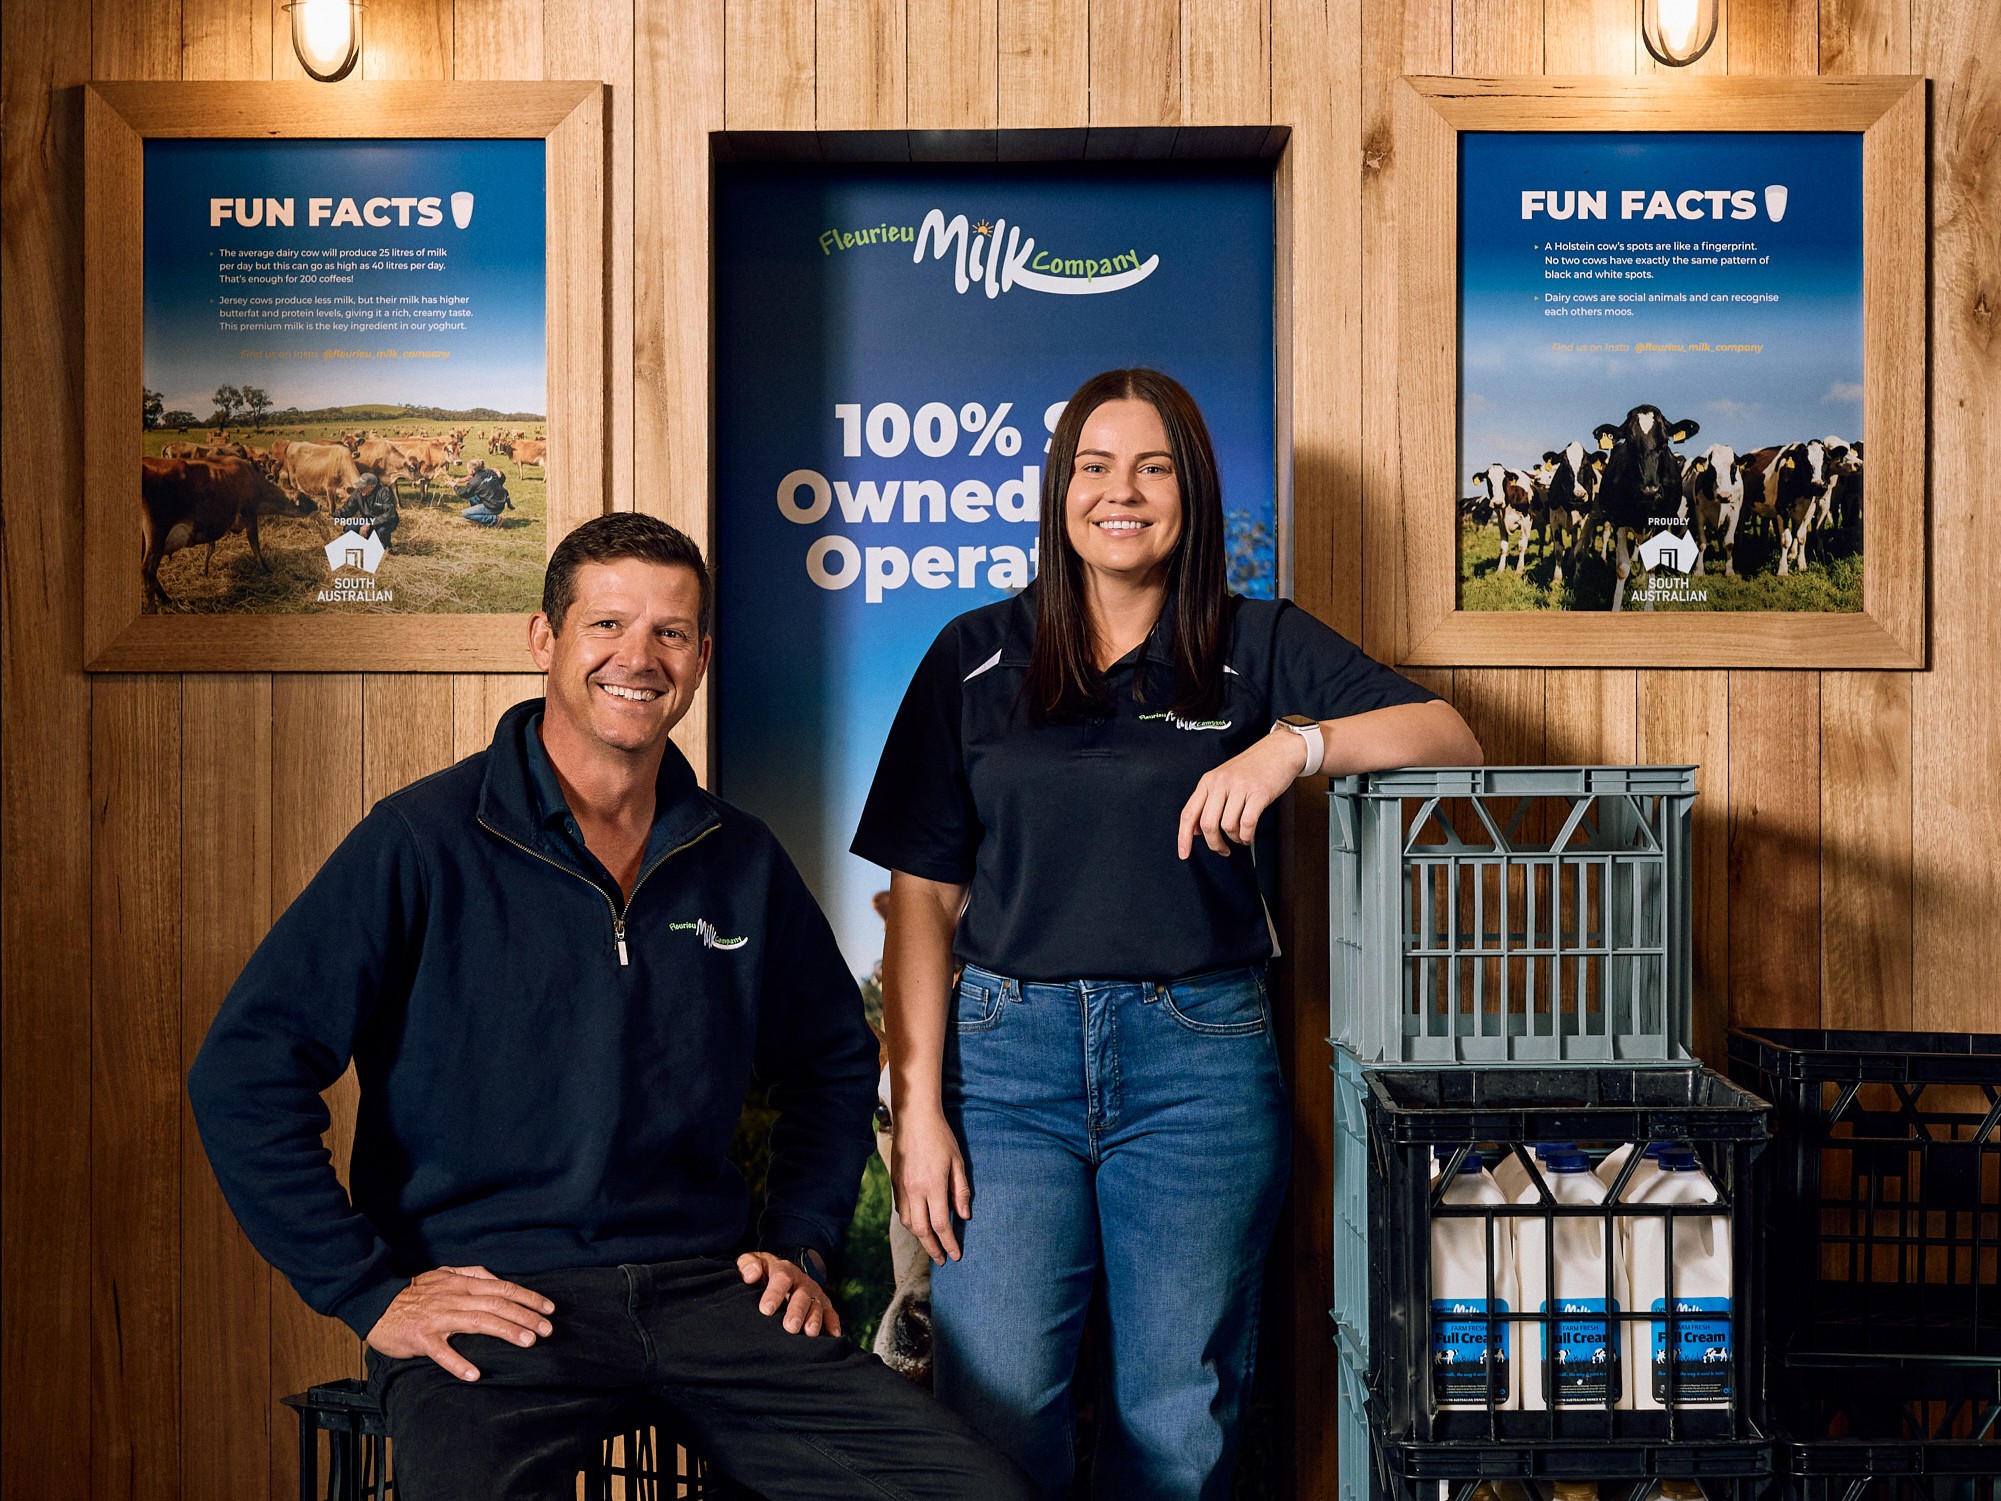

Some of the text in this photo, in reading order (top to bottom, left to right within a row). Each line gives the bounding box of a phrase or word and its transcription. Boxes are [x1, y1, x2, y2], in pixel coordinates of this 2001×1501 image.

[1522, 190, 1756, 220] FUN FACTS
[211, 197, 443, 227] FUN FACTS
[818, 222, 915, 255] Fleurieu
[1032, 249, 1143, 283] Company
[1554, 241, 1595, 251] Holstein
[1596, 241, 1625, 251] cow's
[1626, 242, 1654, 253] spots
[1655, 243, 1672, 251] are
[1673, 241, 1692, 251] like
[1701, 241, 1758, 253] fingerprint.
[219, 247, 448, 260] The average dairy cow will produce 25 litres of milk
[219, 260, 447, 272] per day but this can go as high as 40 litres per day.
[1544, 255, 1770, 267] No two cows have exactly the same pattern of
[219, 273, 354, 286] That's enough for 200 coffees!
[1544, 269, 1654, 281] black and white spots.
[218, 294, 470, 307] Jersey cows produce less milk, but their milk has higher
[1544, 292, 1780, 304] Dairy cows are social animals and can recognise
[219, 308, 260, 318] butterfat
[261, 308, 280, 318] and
[281, 308, 315, 320] protein
[315, 308, 344, 319] levels,
[344, 308, 374, 320] giving
[391, 308, 412, 319] rich,
[412, 309, 448, 319] creamy
[448, 308, 474, 318] taste.
[1543, 306, 1635, 317] each others moos.
[218, 321, 239, 331] This
[239, 321, 283, 333] premium
[283, 321, 305, 331] milk
[314, 321, 332, 331] the
[332, 321, 350, 332] key
[350, 320, 399, 333] ingredient
[399, 321, 409, 331] in
[410, 322, 427, 331] our
[427, 321, 467, 332] yoghurt.
[1552, 343, 1574, 352] Find
[834, 401, 1023, 458] 100%
[776, 465, 1041, 525] Owned
[334, 517, 376, 526] PROUDLY
[1648, 517, 1690, 526] PROUDLY
[334, 577, 376, 590] SOUTH
[1648, 577, 1690, 590] SOUTH
[317, 590, 394, 602] AUSTRALIAN
[1631, 590, 1708, 602] AUSTRALIAN
[668, 921, 697, 932] Fleurieu
[1691, 1323, 1710, 1331] FRESH
[1435, 1331, 1459, 1344] Full
[1553, 1331, 1571, 1344] ull
[1657, 1331, 1726, 1343] Fll Cream
